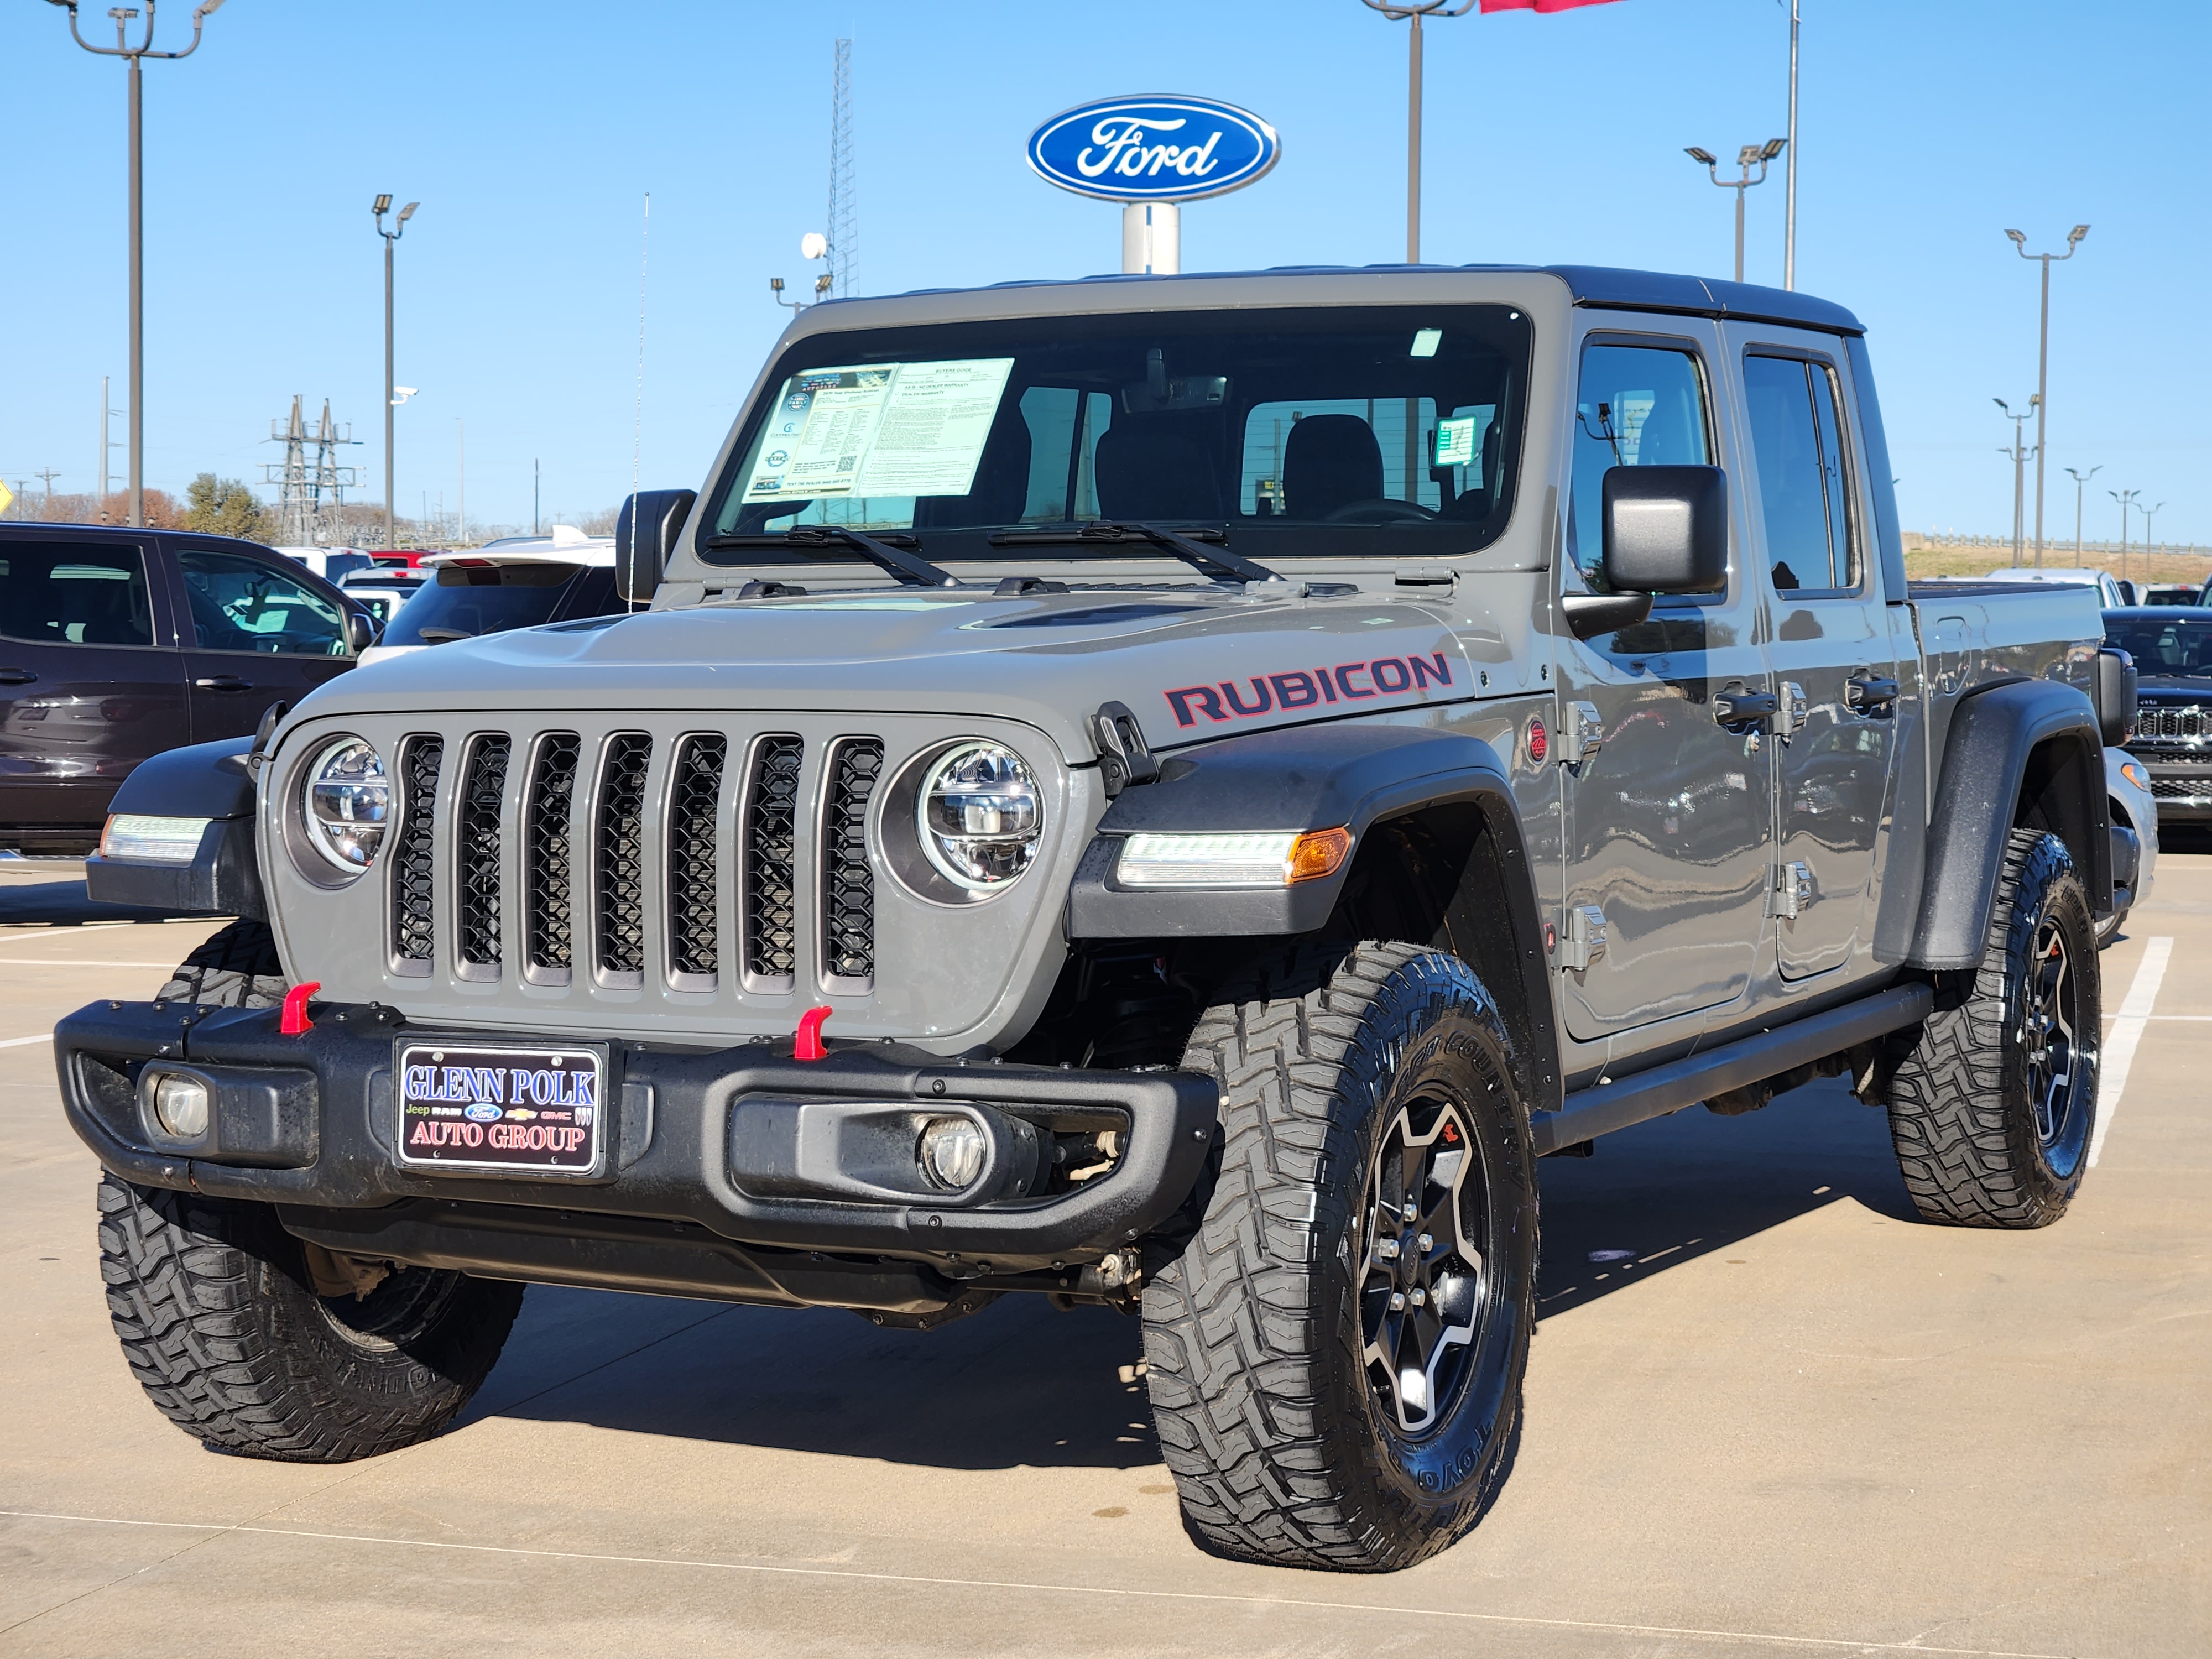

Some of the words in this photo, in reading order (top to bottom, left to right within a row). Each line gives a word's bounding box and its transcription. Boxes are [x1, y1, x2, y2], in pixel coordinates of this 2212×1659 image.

[1077, 116, 1223, 177] Ford
[1164, 651, 1454, 728] RUBICON
[405, 1065, 507, 1103] GLENN
[510, 1068, 595, 1106] POLK
[406, 1104, 430, 1117] Jeep
[431, 1107, 462, 1117] RAM
[472, 1107, 496, 1119] Ford
[540, 1111, 572, 1120] GMC
[410, 1121, 483, 1146] AUTO
[488, 1124, 585, 1151] GROUP
[1417, 1420, 1494, 1493] TOYO
